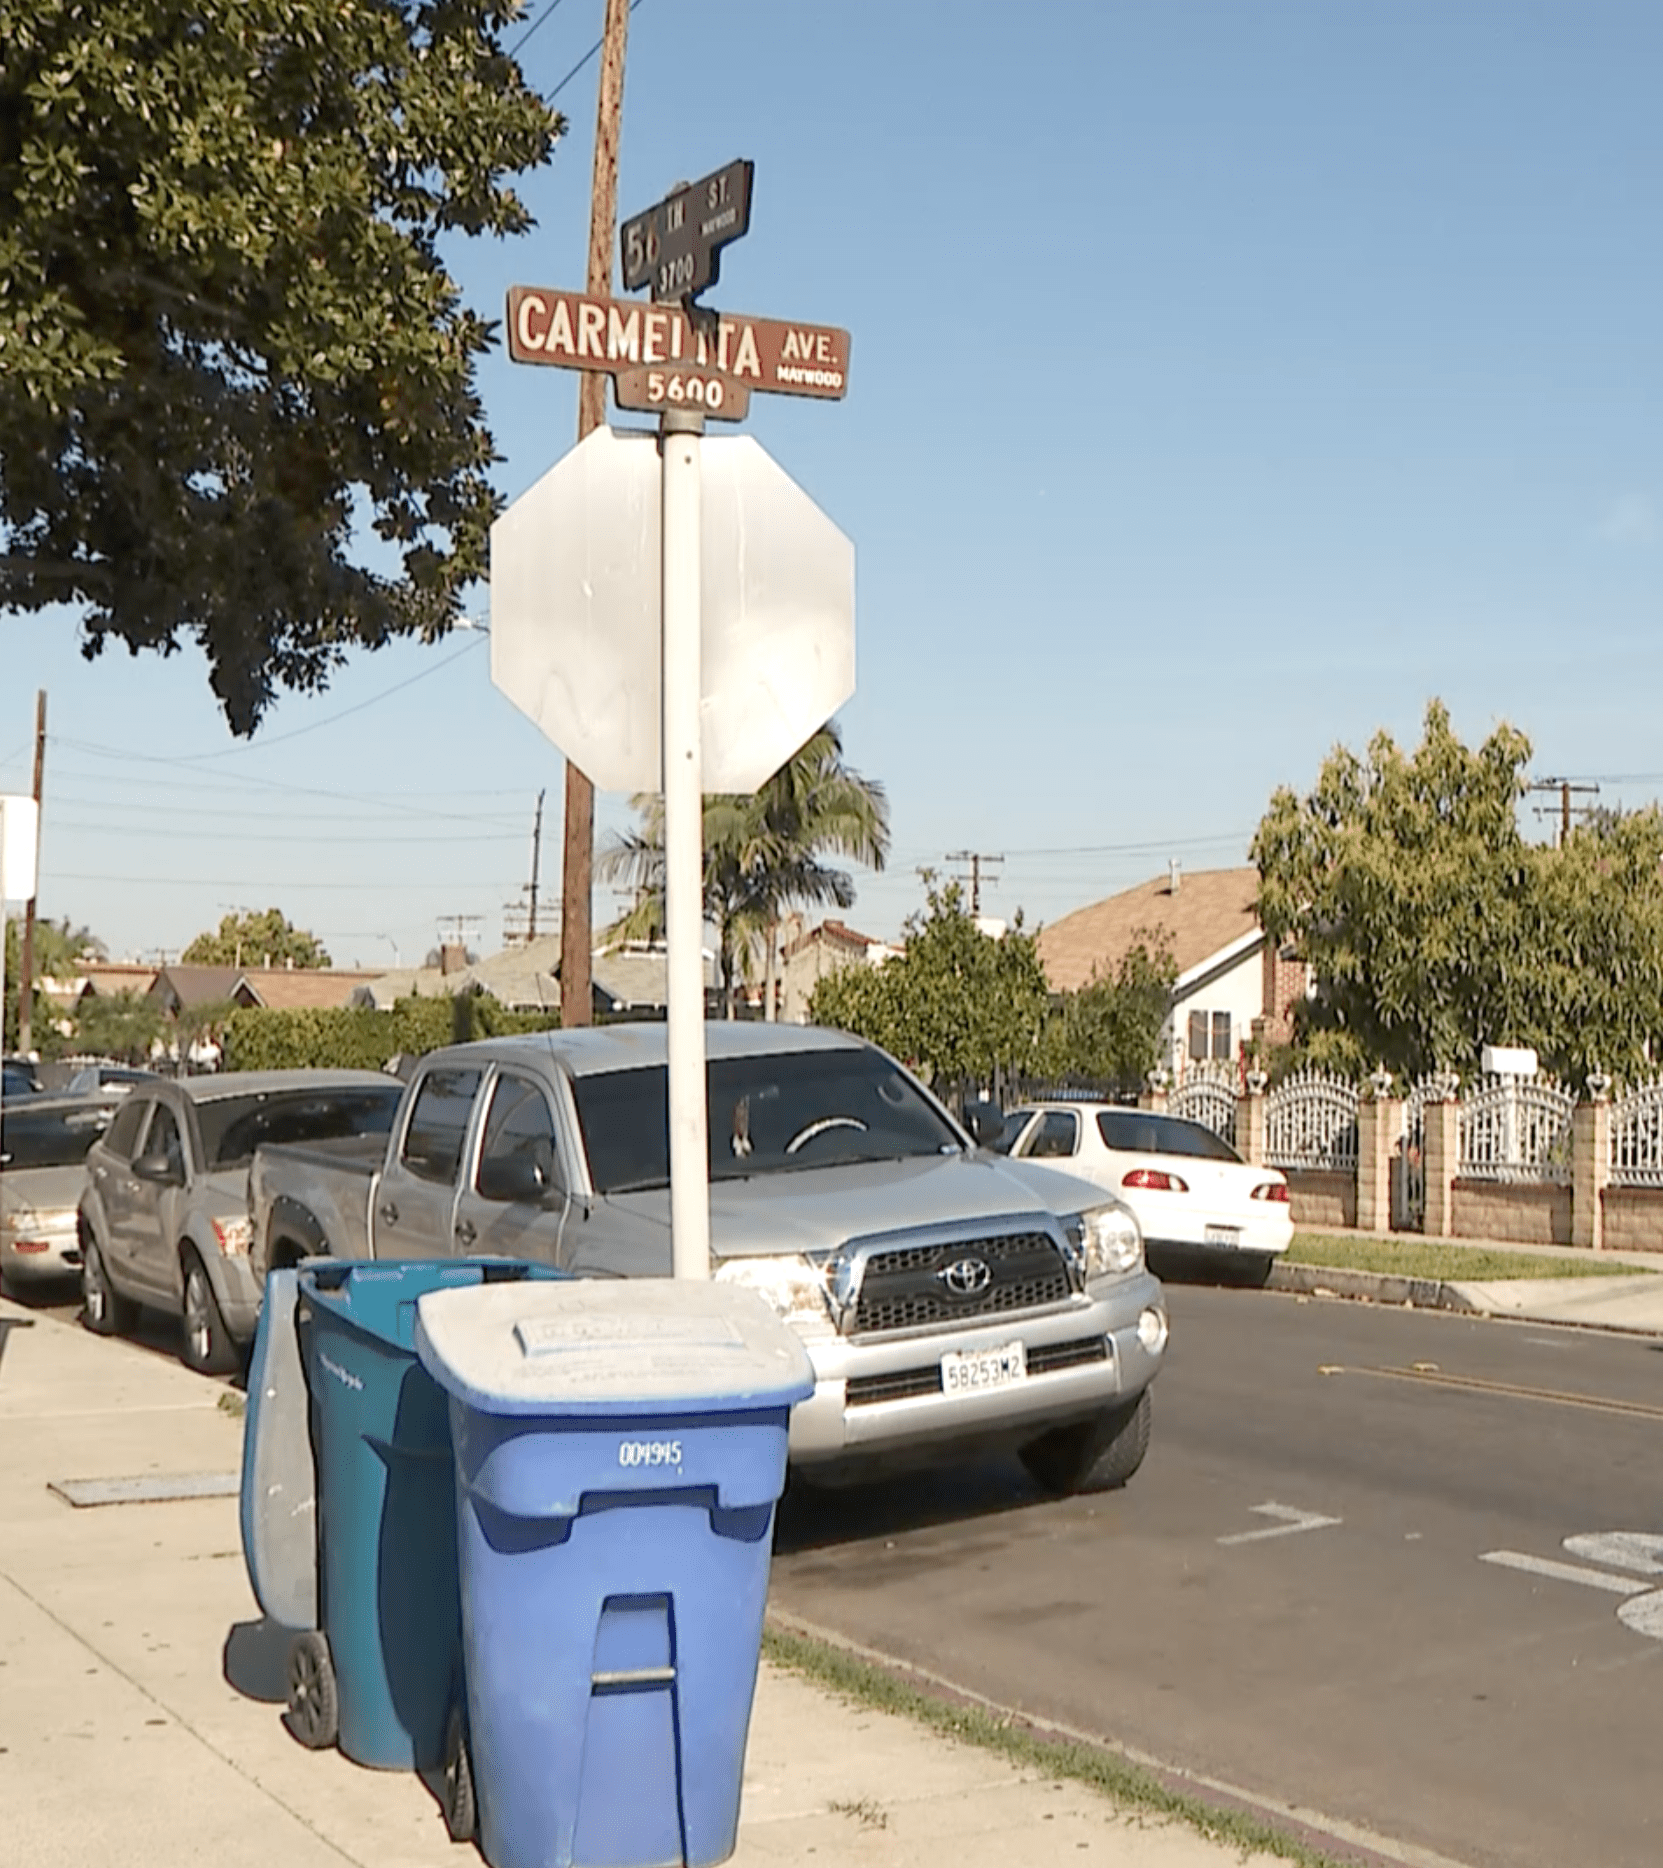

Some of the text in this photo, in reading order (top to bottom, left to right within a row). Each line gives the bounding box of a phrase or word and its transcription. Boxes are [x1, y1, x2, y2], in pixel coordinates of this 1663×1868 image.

[781, 328, 838, 364] AVE.
[647, 373, 723, 408] 5600
[777, 365, 842, 388] MAYWOOD
